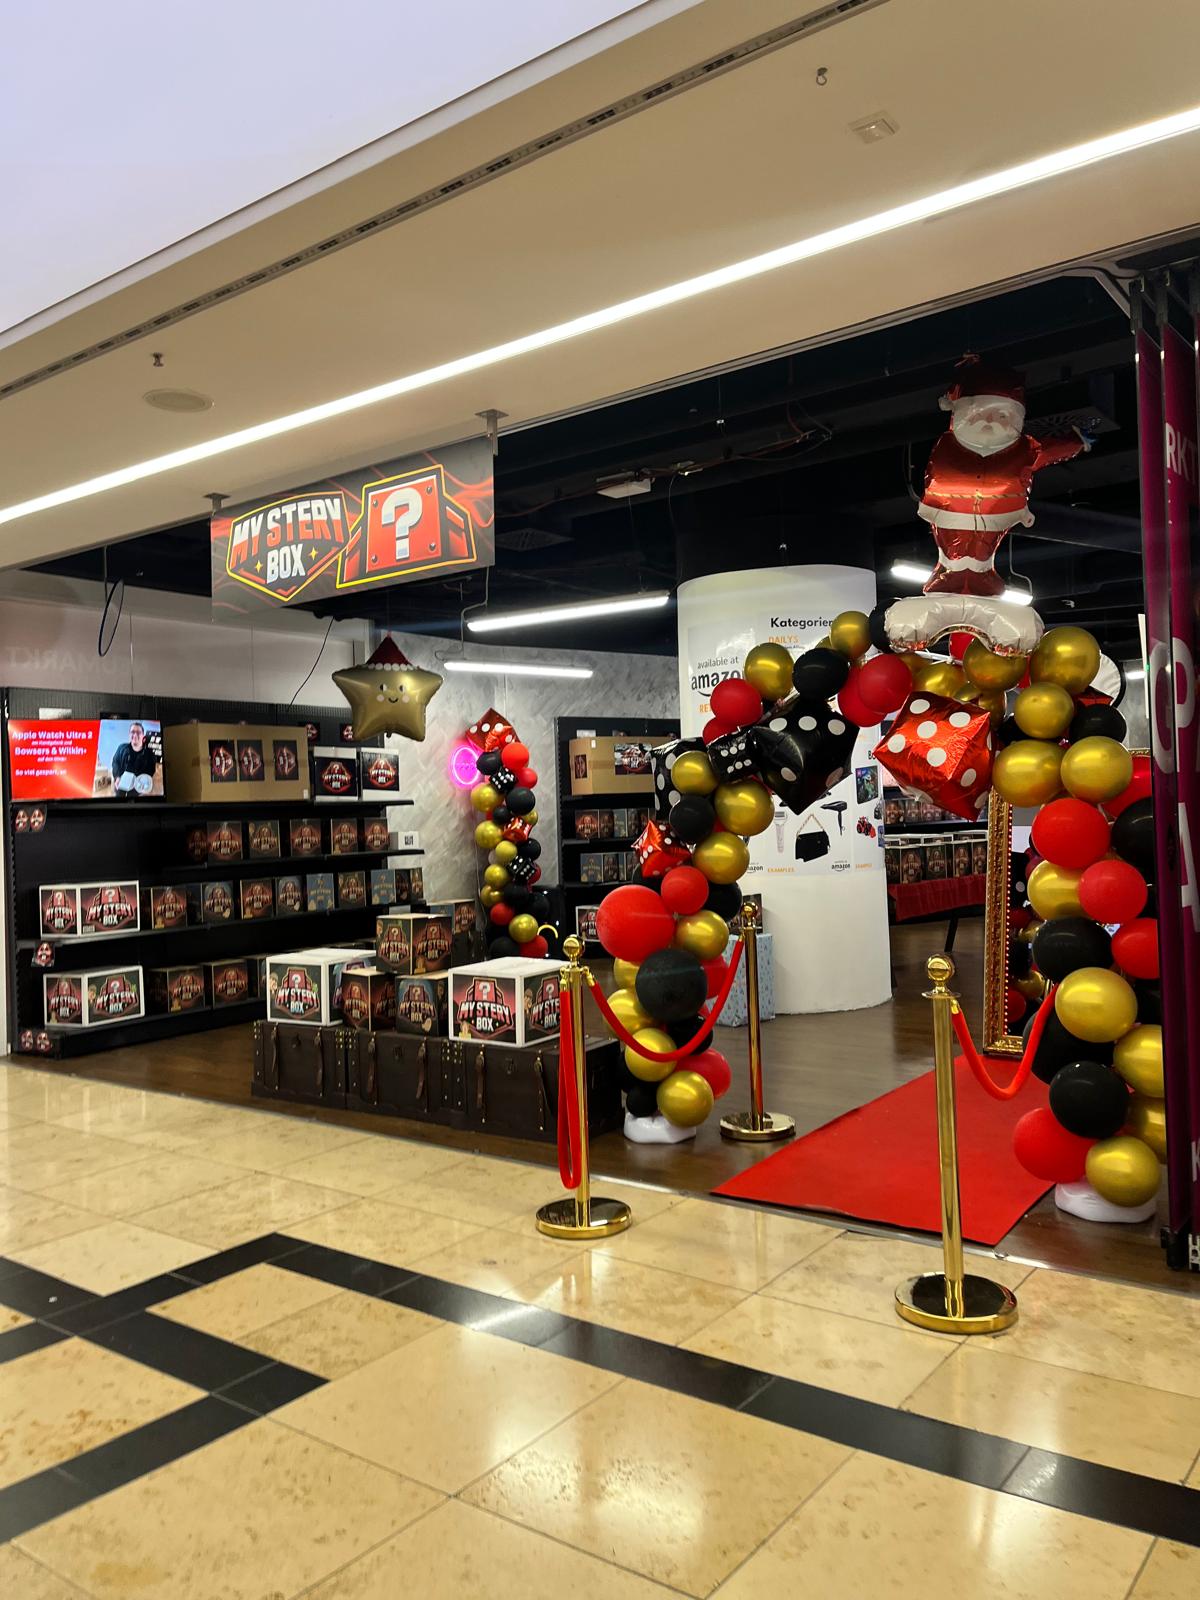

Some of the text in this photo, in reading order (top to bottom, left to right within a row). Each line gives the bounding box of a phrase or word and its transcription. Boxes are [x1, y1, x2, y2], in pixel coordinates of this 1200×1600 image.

[230, 498, 344, 569] MYSTERY
[267, 543, 306, 584] BOX
[698, 656, 739, 669] available at
[12, 730, 93, 740] Apple Watch Ultra 2
[51, 747, 57, 755] &
[45, 906, 74, 920] MYSTERY
[86, 903, 134, 920] MYSTERY
[54, 918, 65, 928] BOX
[103, 915, 118, 926] BOX
[379, 941, 410, 954] MYSTERY
[417, 939, 449, 954] MYSTERY
[389, 952, 399, 961] BOX
[427, 950, 438, 959] BOX
[96, 991, 137, 1010] MYSTERY
[277, 988, 318, 1007] MYSTERY
[109, 1002, 124, 1014] BOX
[290, 1001, 304, 1014] BOX
[399, 1001, 436, 1017] MYSTERY
[459, 1001, 511, 1025] MYSTERY
[411, 1012, 423, 1022] BOX
[544, 1013, 558, 1028] BOX
[476, 1017, 494, 1032] BOX
